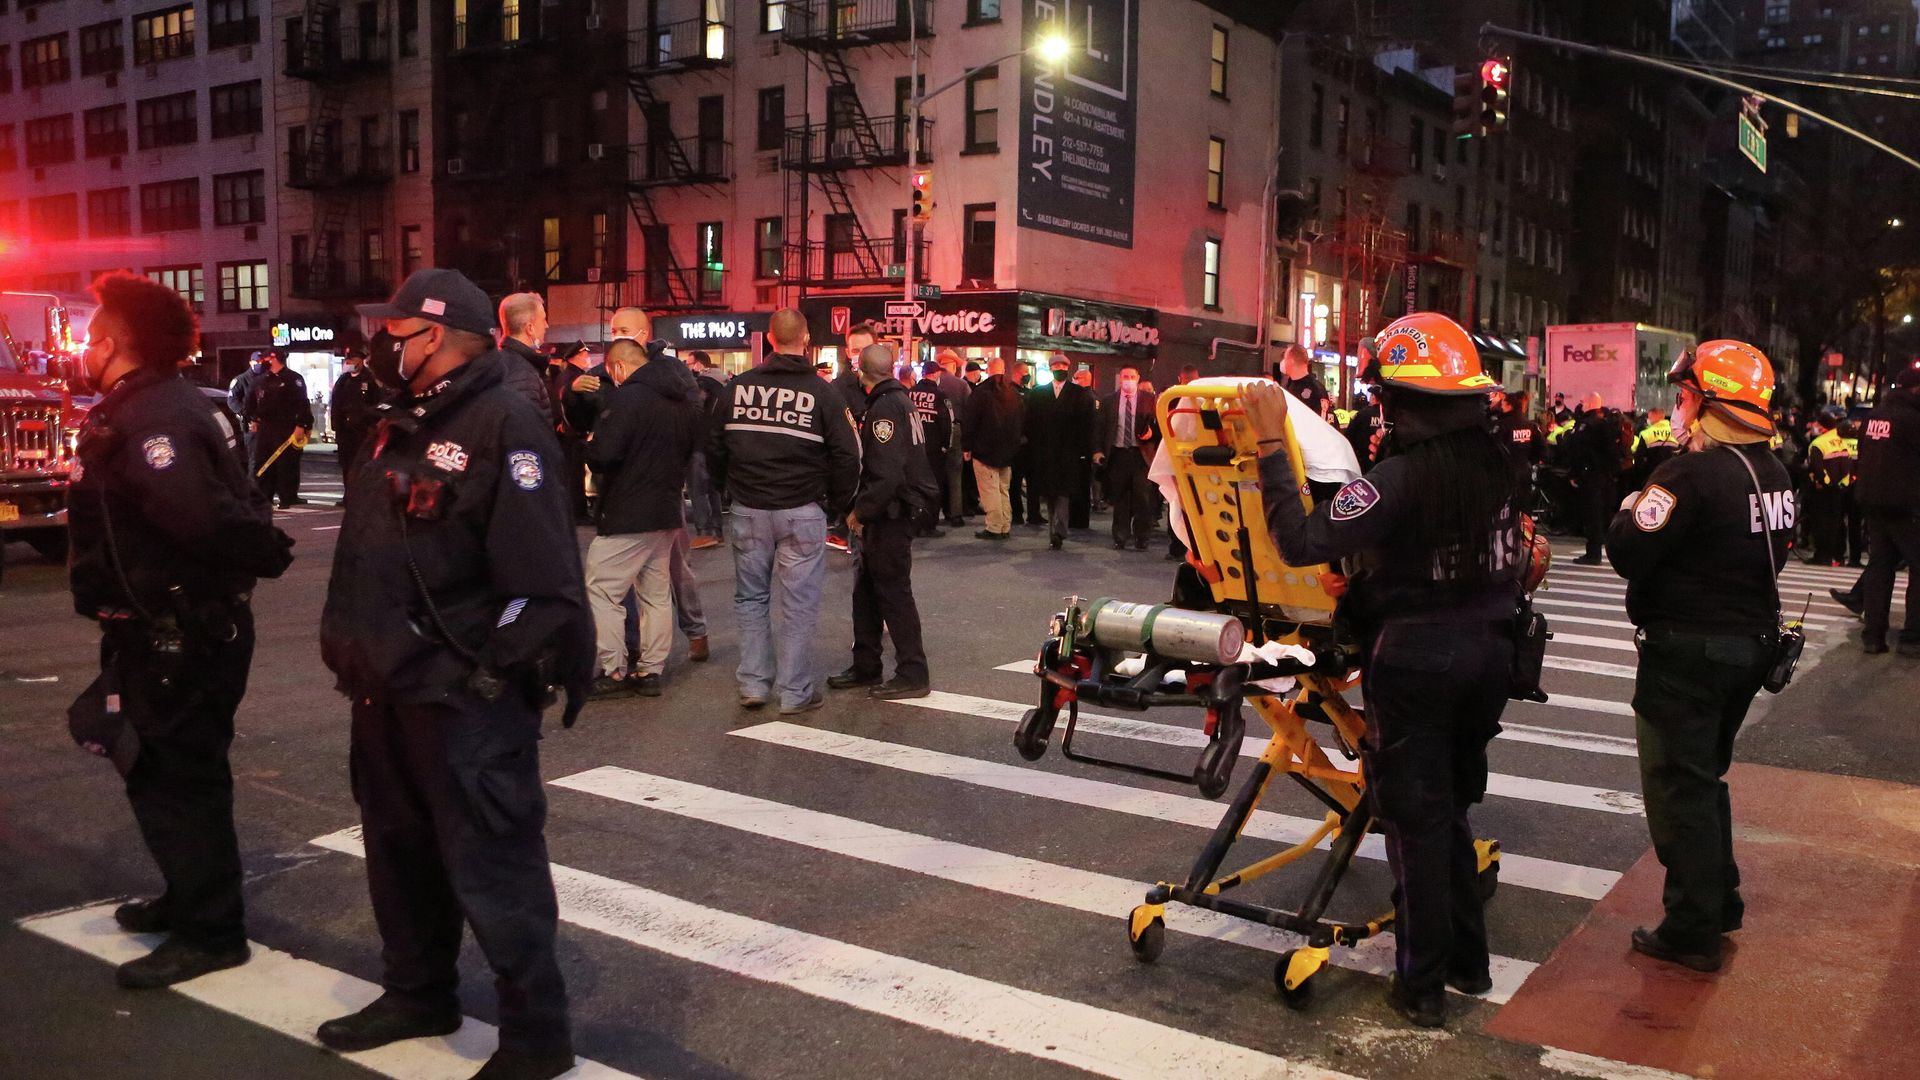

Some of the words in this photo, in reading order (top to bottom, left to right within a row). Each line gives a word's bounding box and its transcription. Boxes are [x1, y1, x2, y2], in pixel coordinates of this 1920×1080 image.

[907, 306, 920, 314] WAY
[290, 327, 311, 341] Nail
[311, 326, 334, 341] One
[680, 322, 707, 339] THE
[708, 321, 735, 338] PHO
[737, 321, 746, 338] 5
[1108, 319, 1160, 346] Venice
[1563, 344, 1618, 362] FedEx
[734, 385, 815, 414] NYPD
[732, 406, 813, 428] POLICE
[1513, 429, 1531, 440] NYPD
[1865, 419, 1892, 435] NYPD
[511, 452, 539, 466] POLICE
[1748, 489, 1795, 533] EMS
